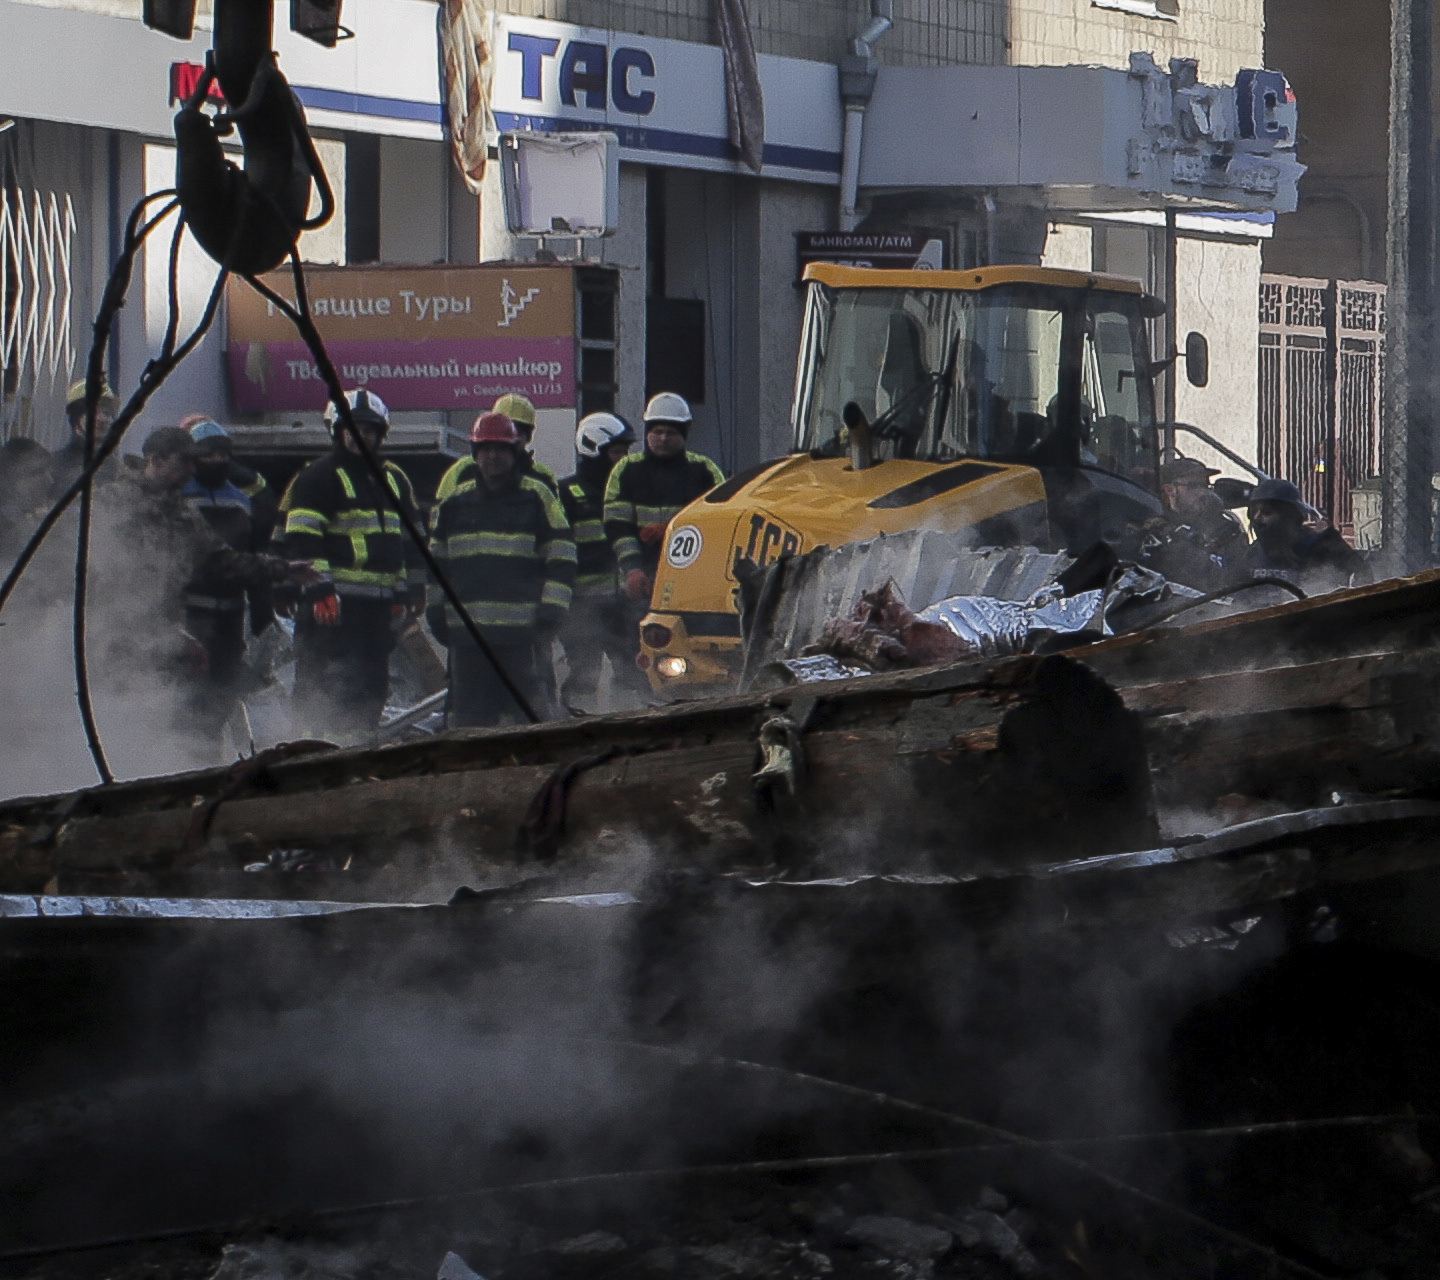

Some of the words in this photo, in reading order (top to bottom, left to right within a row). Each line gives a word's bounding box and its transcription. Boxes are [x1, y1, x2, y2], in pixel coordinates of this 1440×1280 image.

[508, 32, 657, 116] ТАС
[399, 290, 472, 321] Туры
[343, 359, 460, 384] идеальный
[465, 357, 562, 381] маникюр
[532, 383, 562, 395] 11/13
[671, 536, 695, 557] 20
[733, 513, 799, 569] JCB
